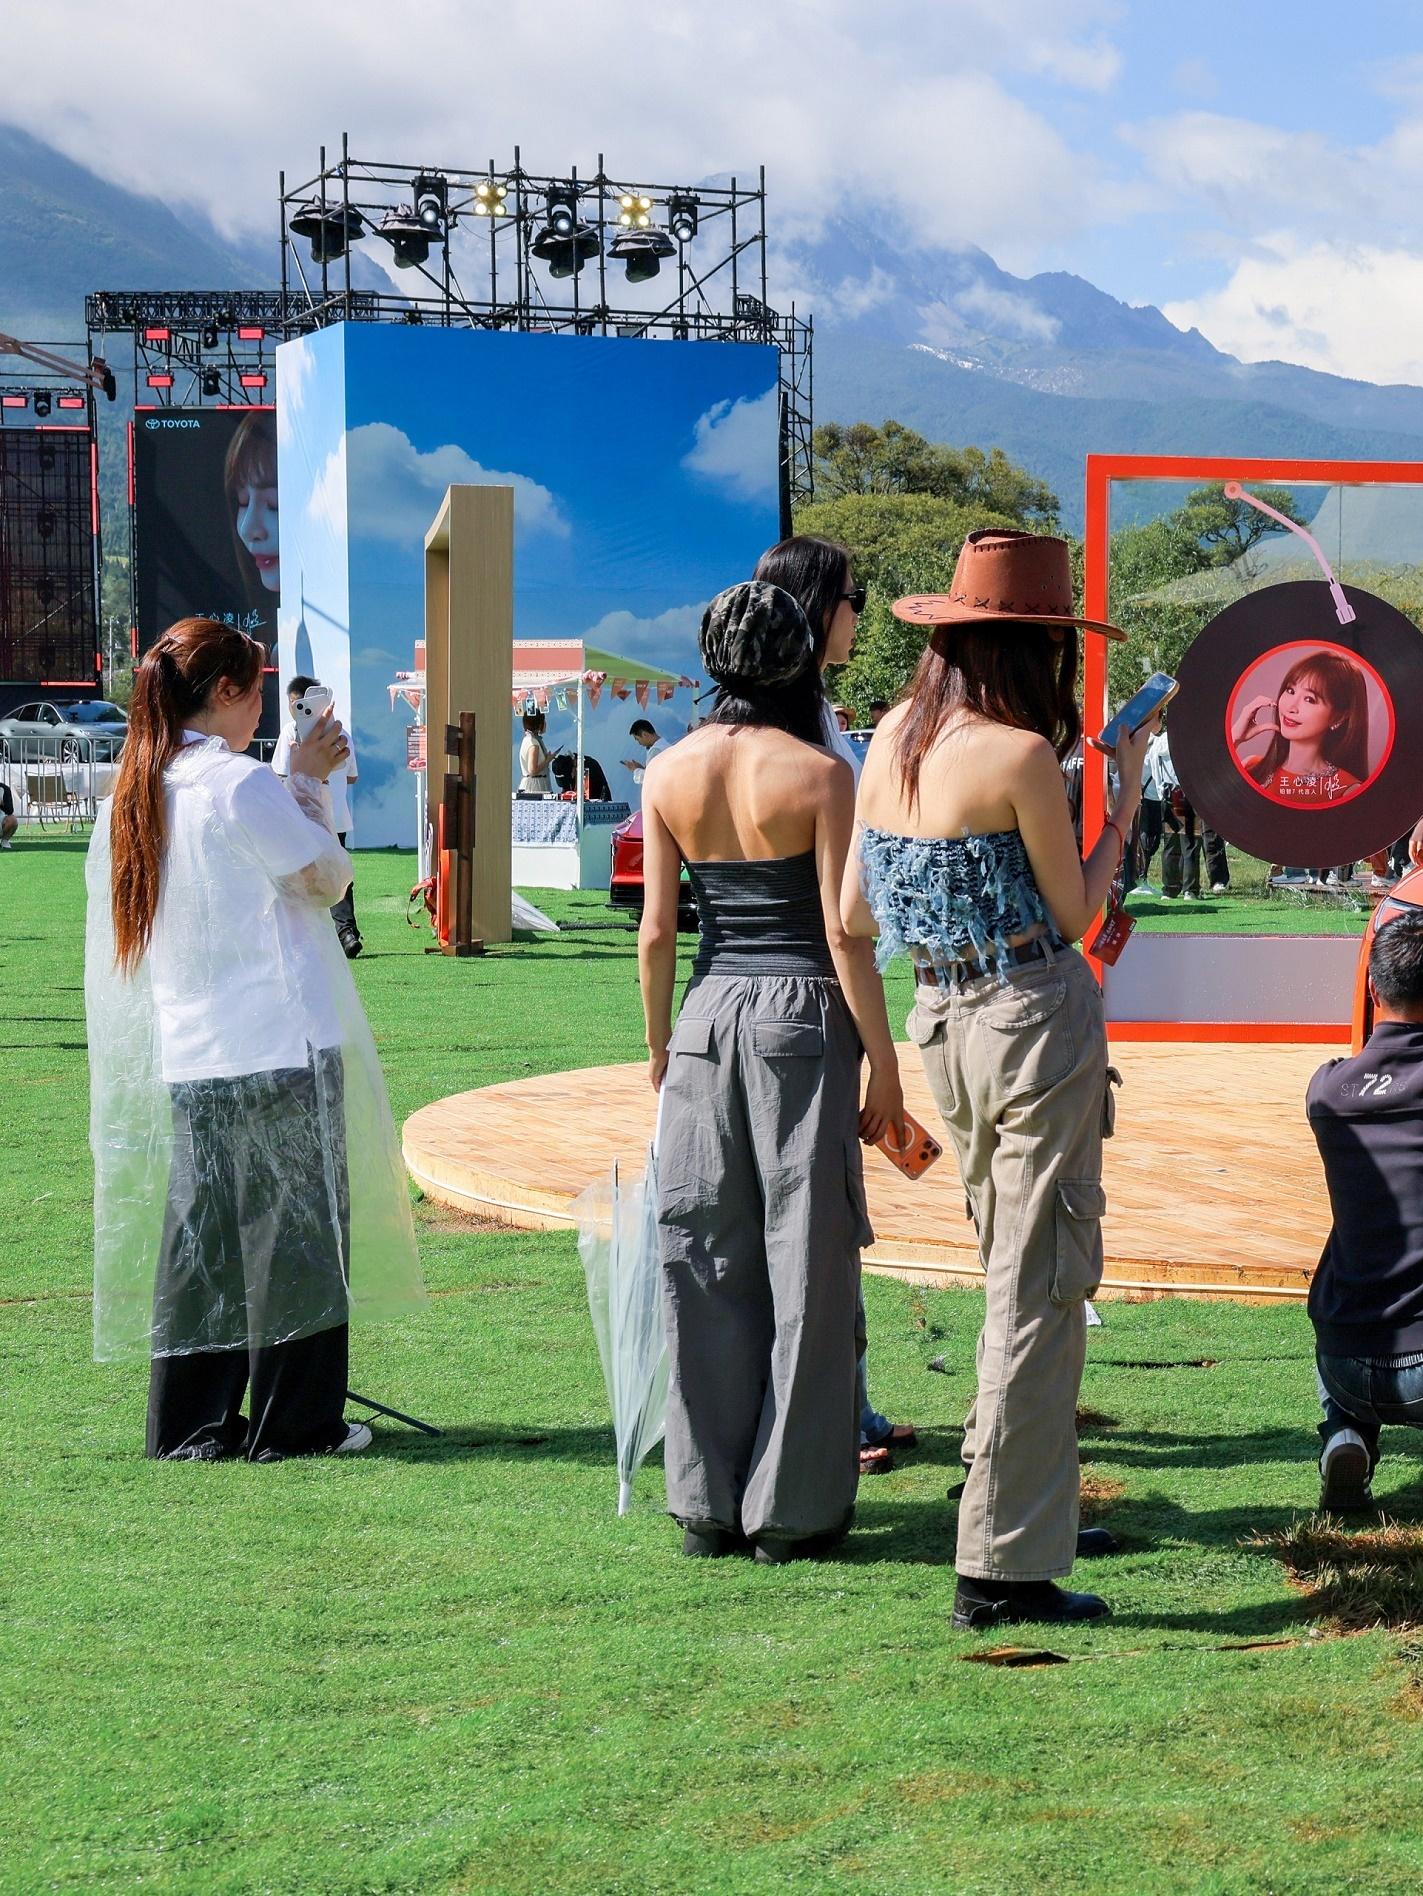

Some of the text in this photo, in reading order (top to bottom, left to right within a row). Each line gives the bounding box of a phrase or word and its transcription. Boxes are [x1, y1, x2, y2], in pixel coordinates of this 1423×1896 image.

[161, 420, 200, 429] TOYOTA
[1280, 776, 1318, 787] 王心凌
[1358, 1073, 1393, 1097] 72
